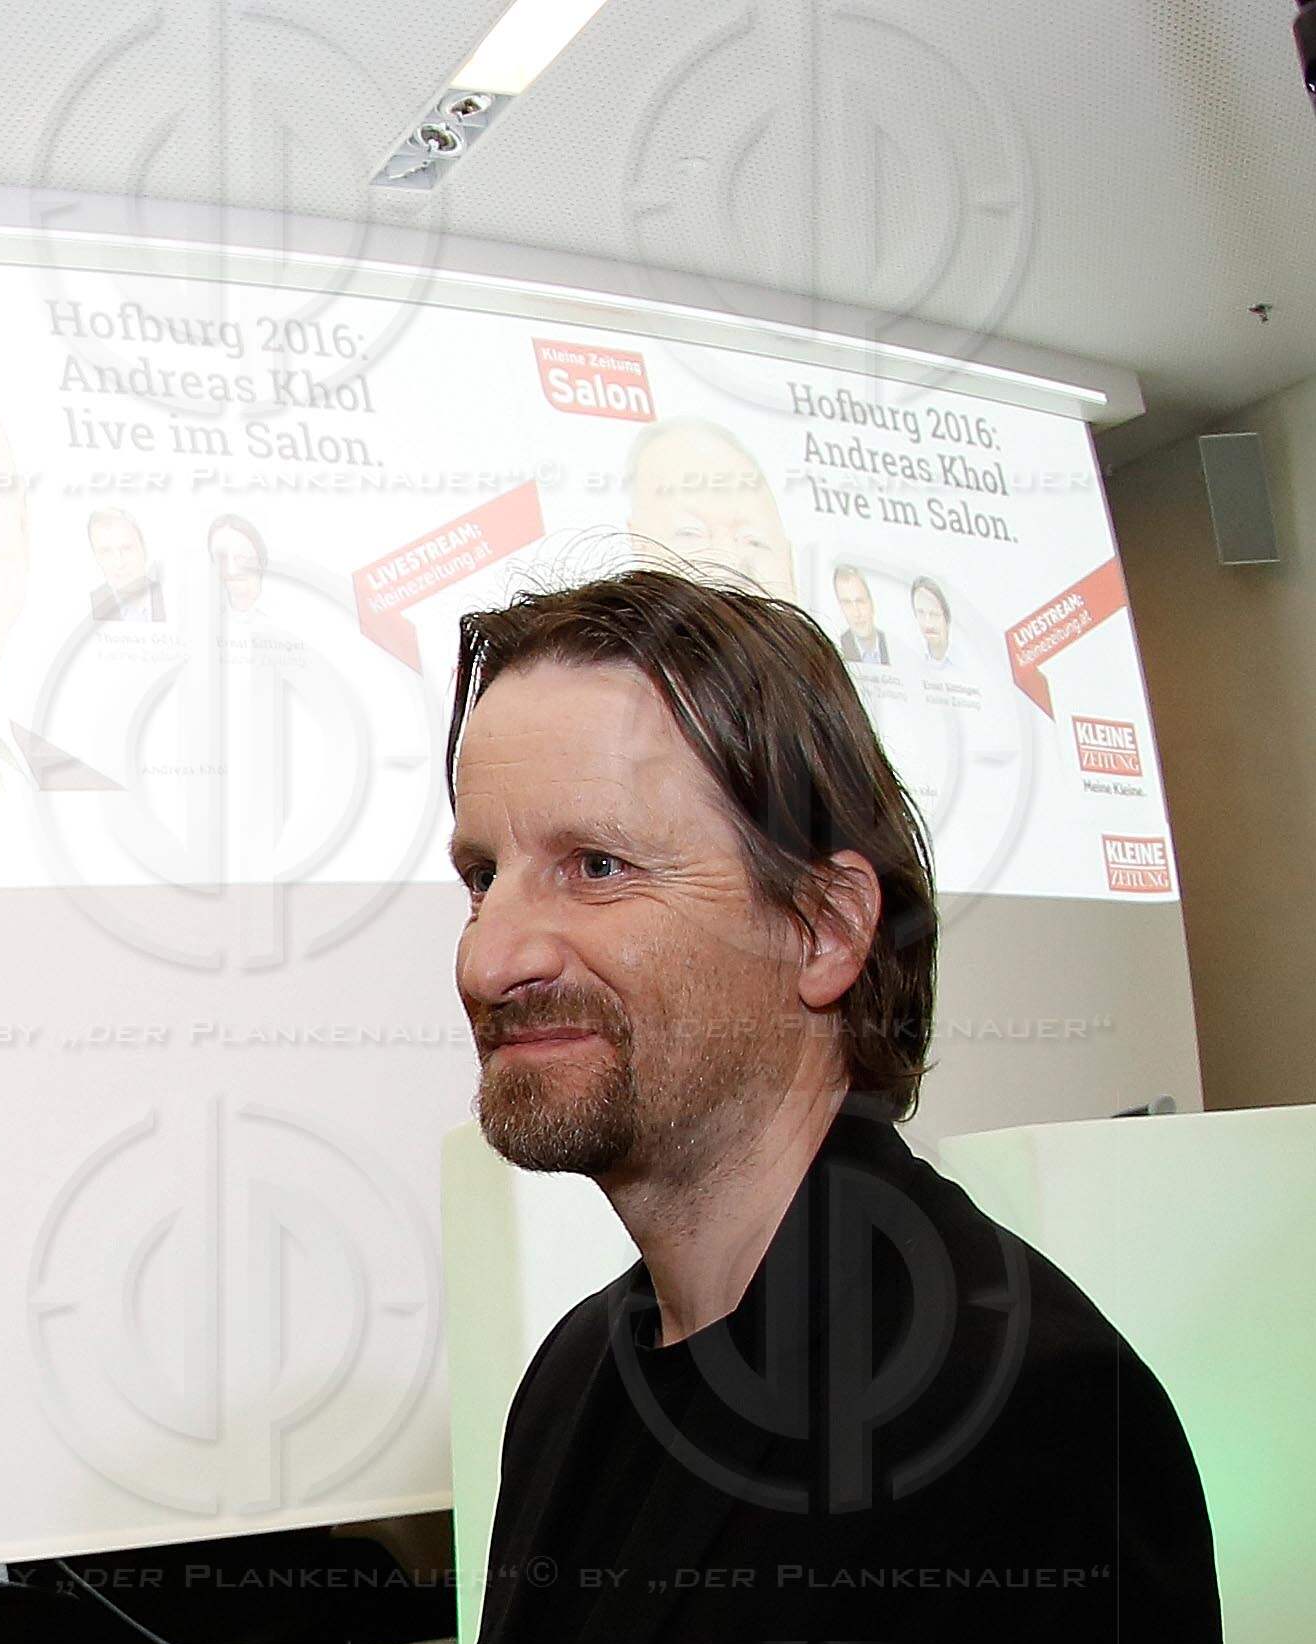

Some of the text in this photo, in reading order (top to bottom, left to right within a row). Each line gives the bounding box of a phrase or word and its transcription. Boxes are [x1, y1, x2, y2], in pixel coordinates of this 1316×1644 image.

[43, 299, 370, 361] Hofburg 2016:
[58, 354, 376, 414] Andreas Khol
[540, 347, 642, 376] Kleine Zeitung
[548, 368, 651, 416] Salon
[786, 381, 1002, 451] Hofburg 2016:
[61, 406, 385, 468] live im Salon.
[804, 430, 932, 484] Andreas
[936, 453, 1010, 497] Khol
[806, 475, 1020, 543] live im Salon.
[367, 522, 484, 590] LIVESTREAM:
[368, 541, 494, 613] kleinezeitung.at
[1013, 593, 1086, 647] LIVESTREAM:
[1075, 721, 1136, 750] KLEINE
[1081, 750, 1140, 771] ZEITUNG
[1105, 840, 1167, 866] KLEINE
[1110, 868, 1169, 888] ZEITUNG
